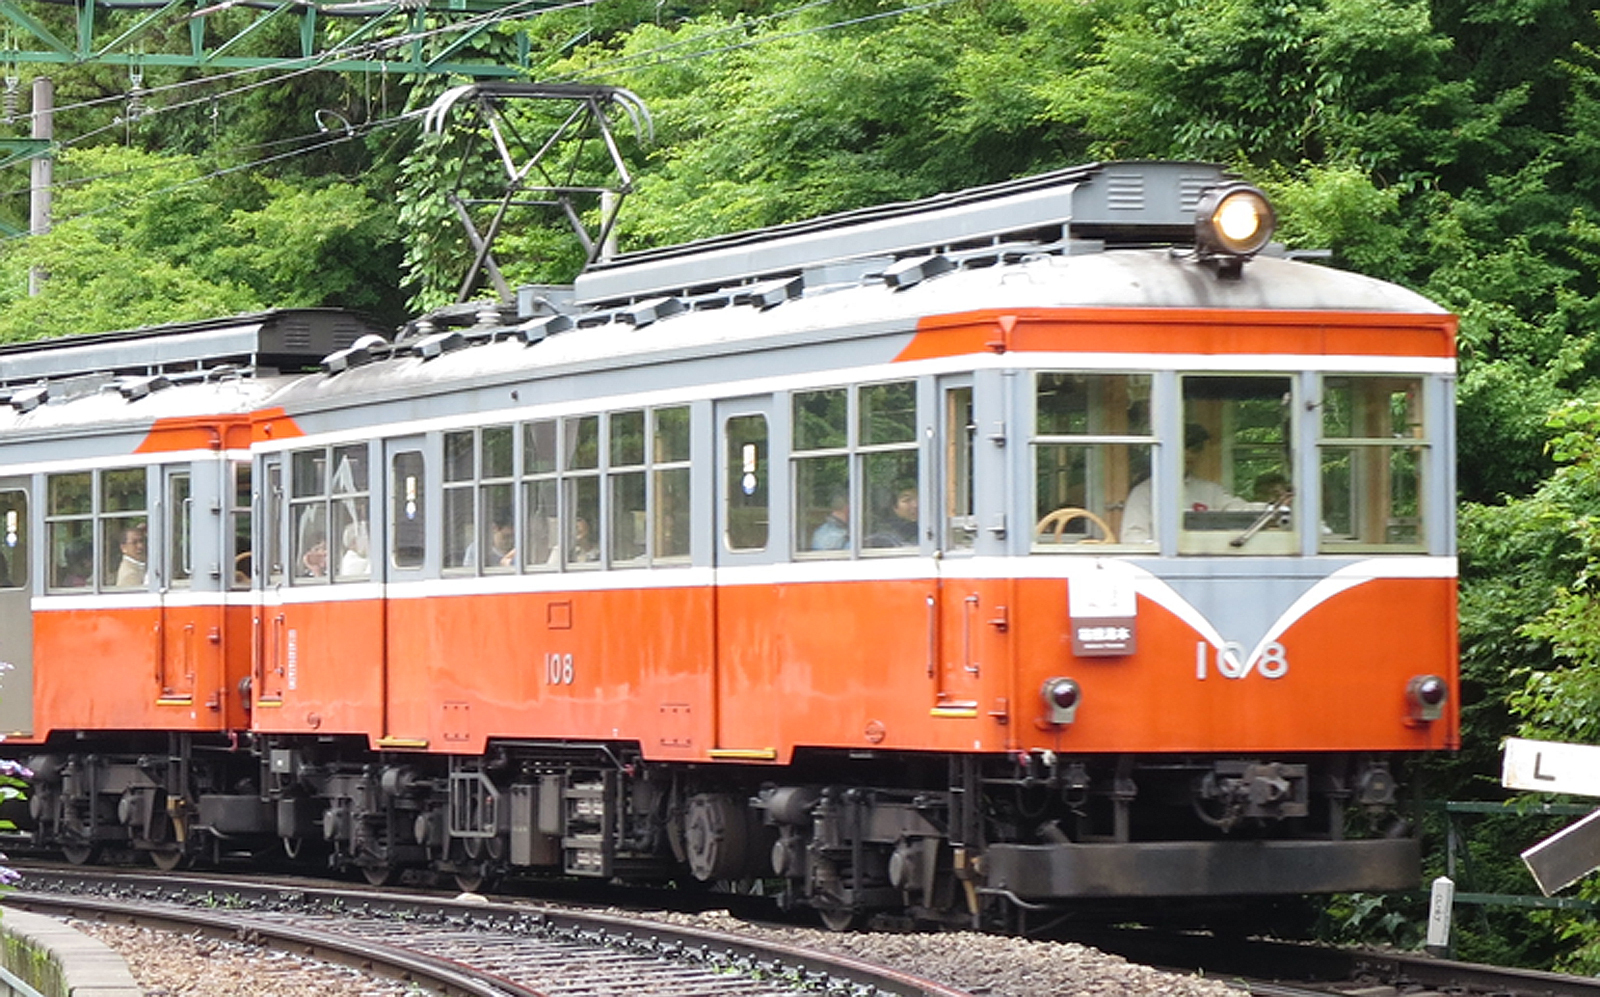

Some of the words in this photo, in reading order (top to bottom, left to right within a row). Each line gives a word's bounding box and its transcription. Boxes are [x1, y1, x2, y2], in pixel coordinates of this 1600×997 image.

[545, 653, 573, 685] 108
[1196, 641, 1289, 679] 108
[1534, 752, 1556, 781] L
